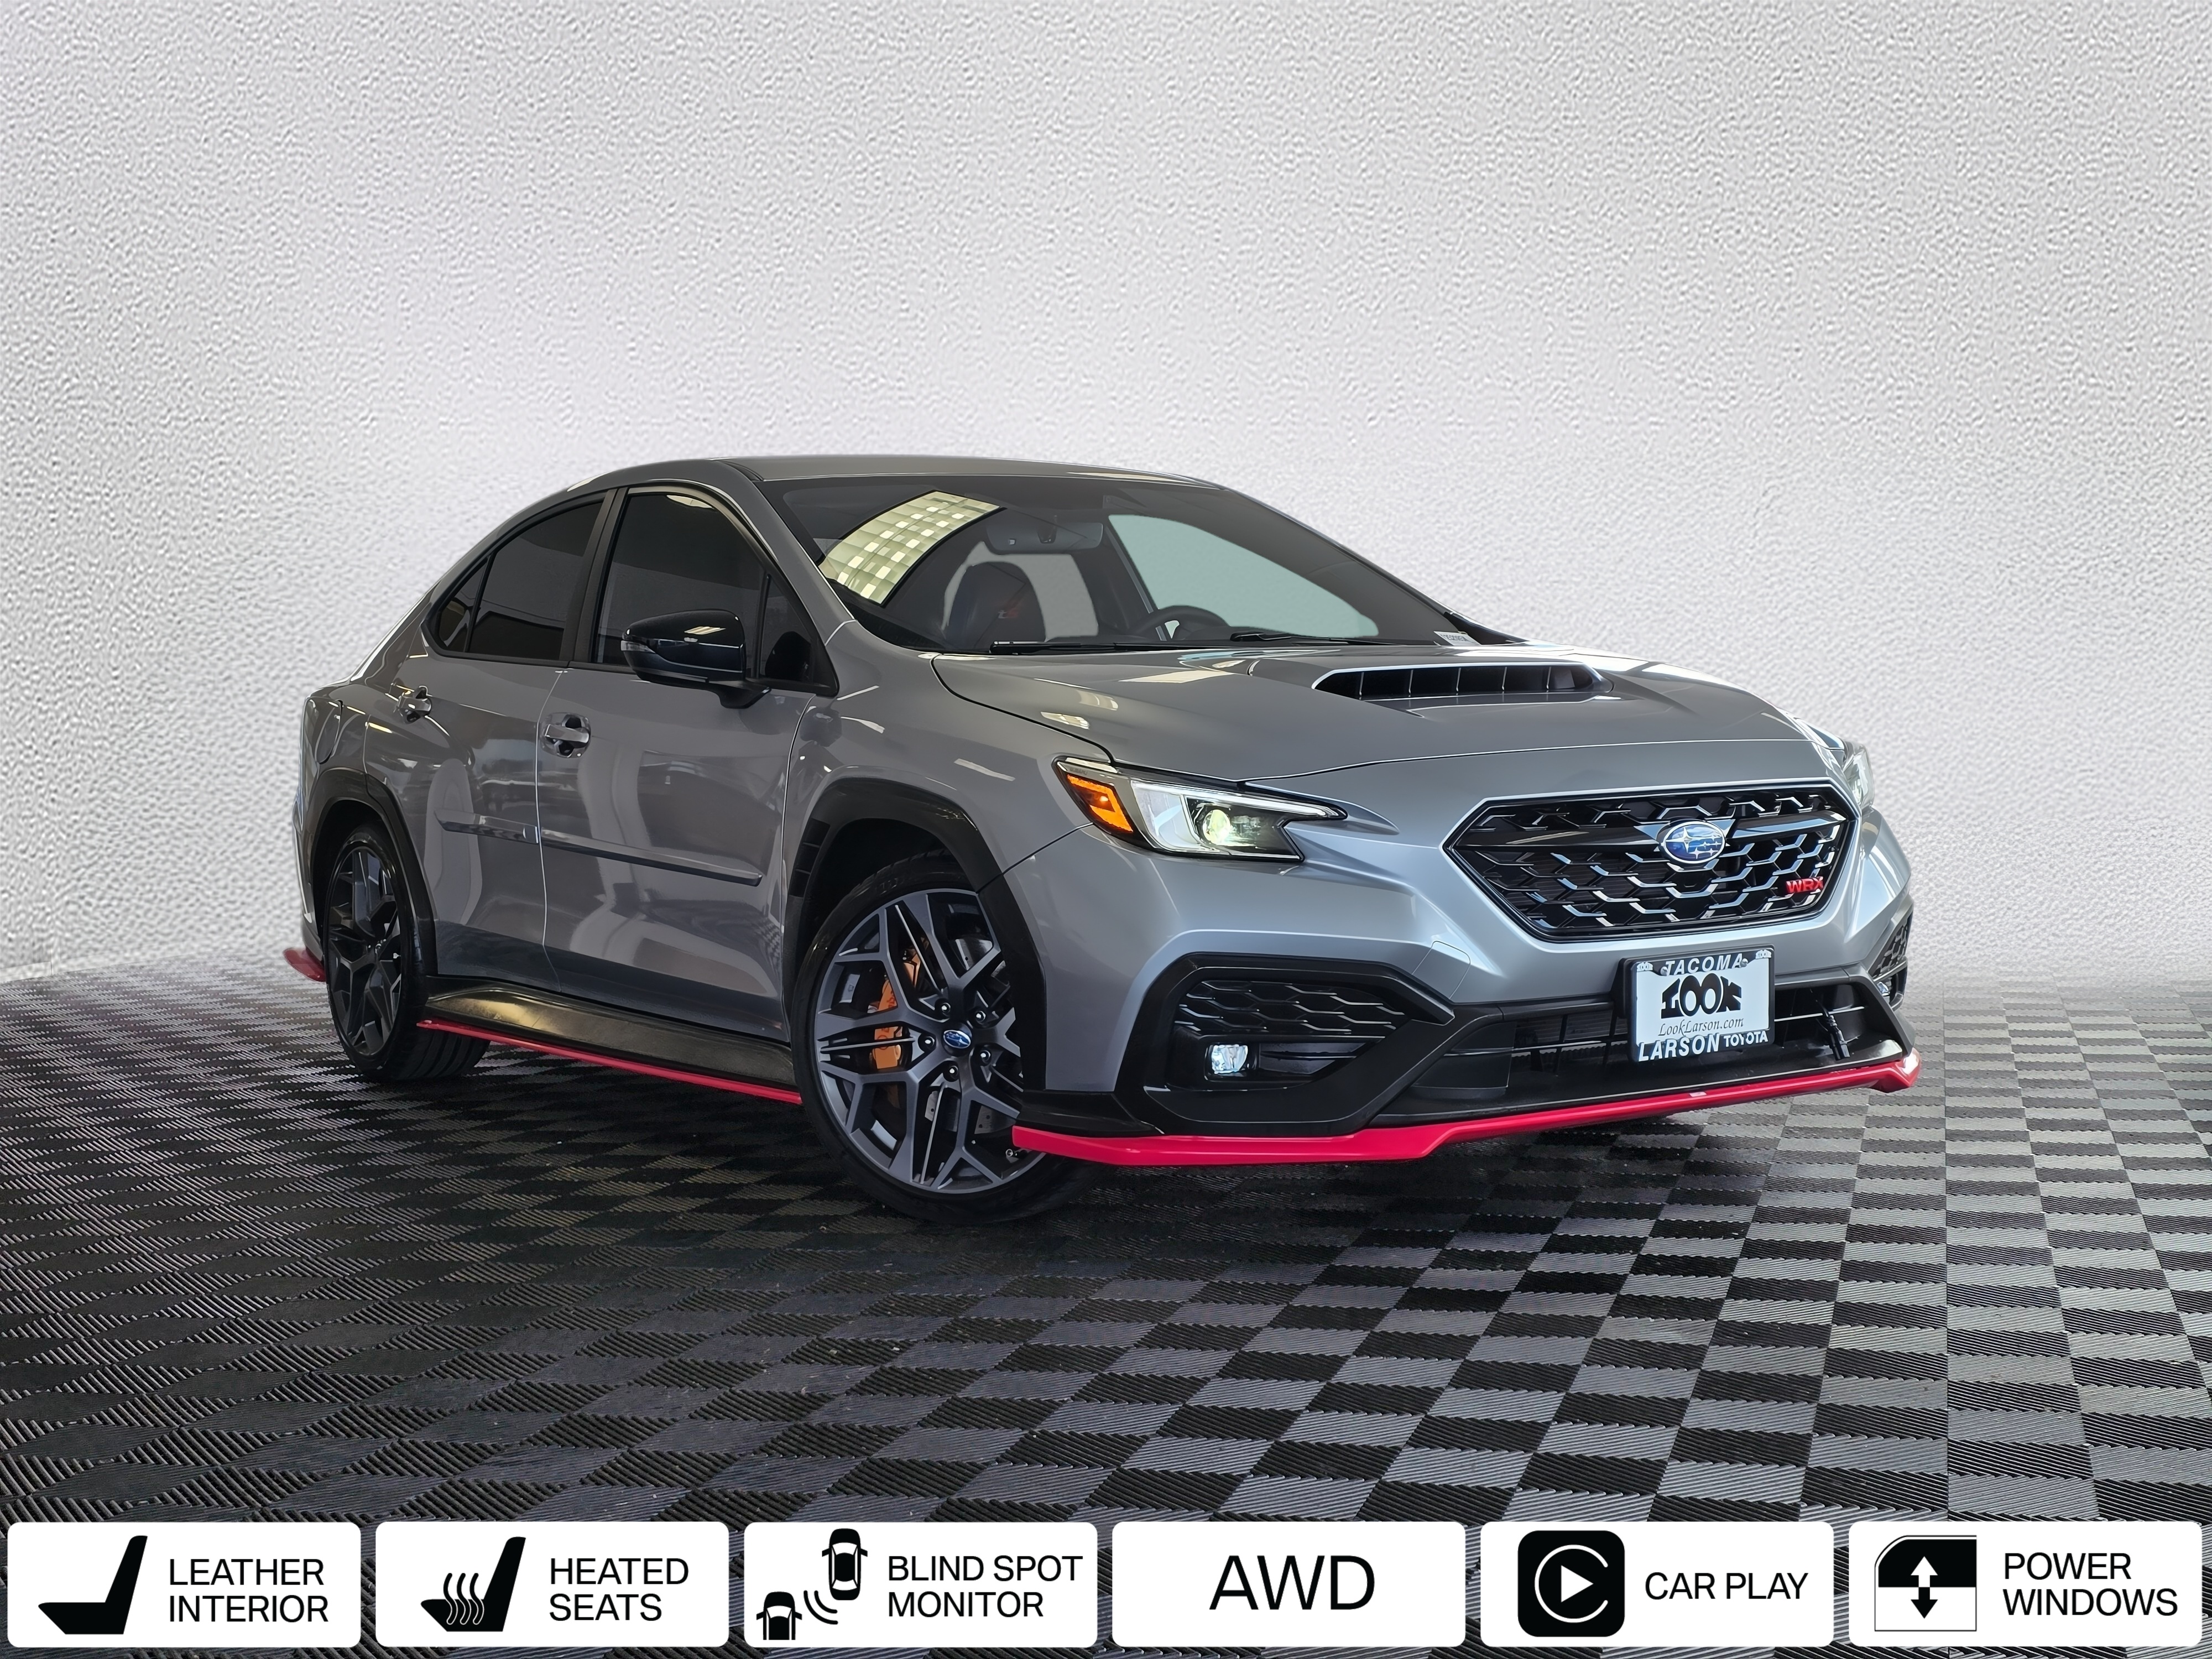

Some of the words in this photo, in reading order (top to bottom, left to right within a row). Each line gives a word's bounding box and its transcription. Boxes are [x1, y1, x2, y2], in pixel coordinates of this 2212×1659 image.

[1786, 876, 1824, 894] WRX
[1665, 953, 1743, 976] TACOMA
[1661, 973, 1742, 1019] LOOK
[1657, 1018, 1744, 1036] LookLarson.com
[1638, 1032, 1720, 1062] LARSON
[1723, 1030, 1768, 1047] TOYOTA
